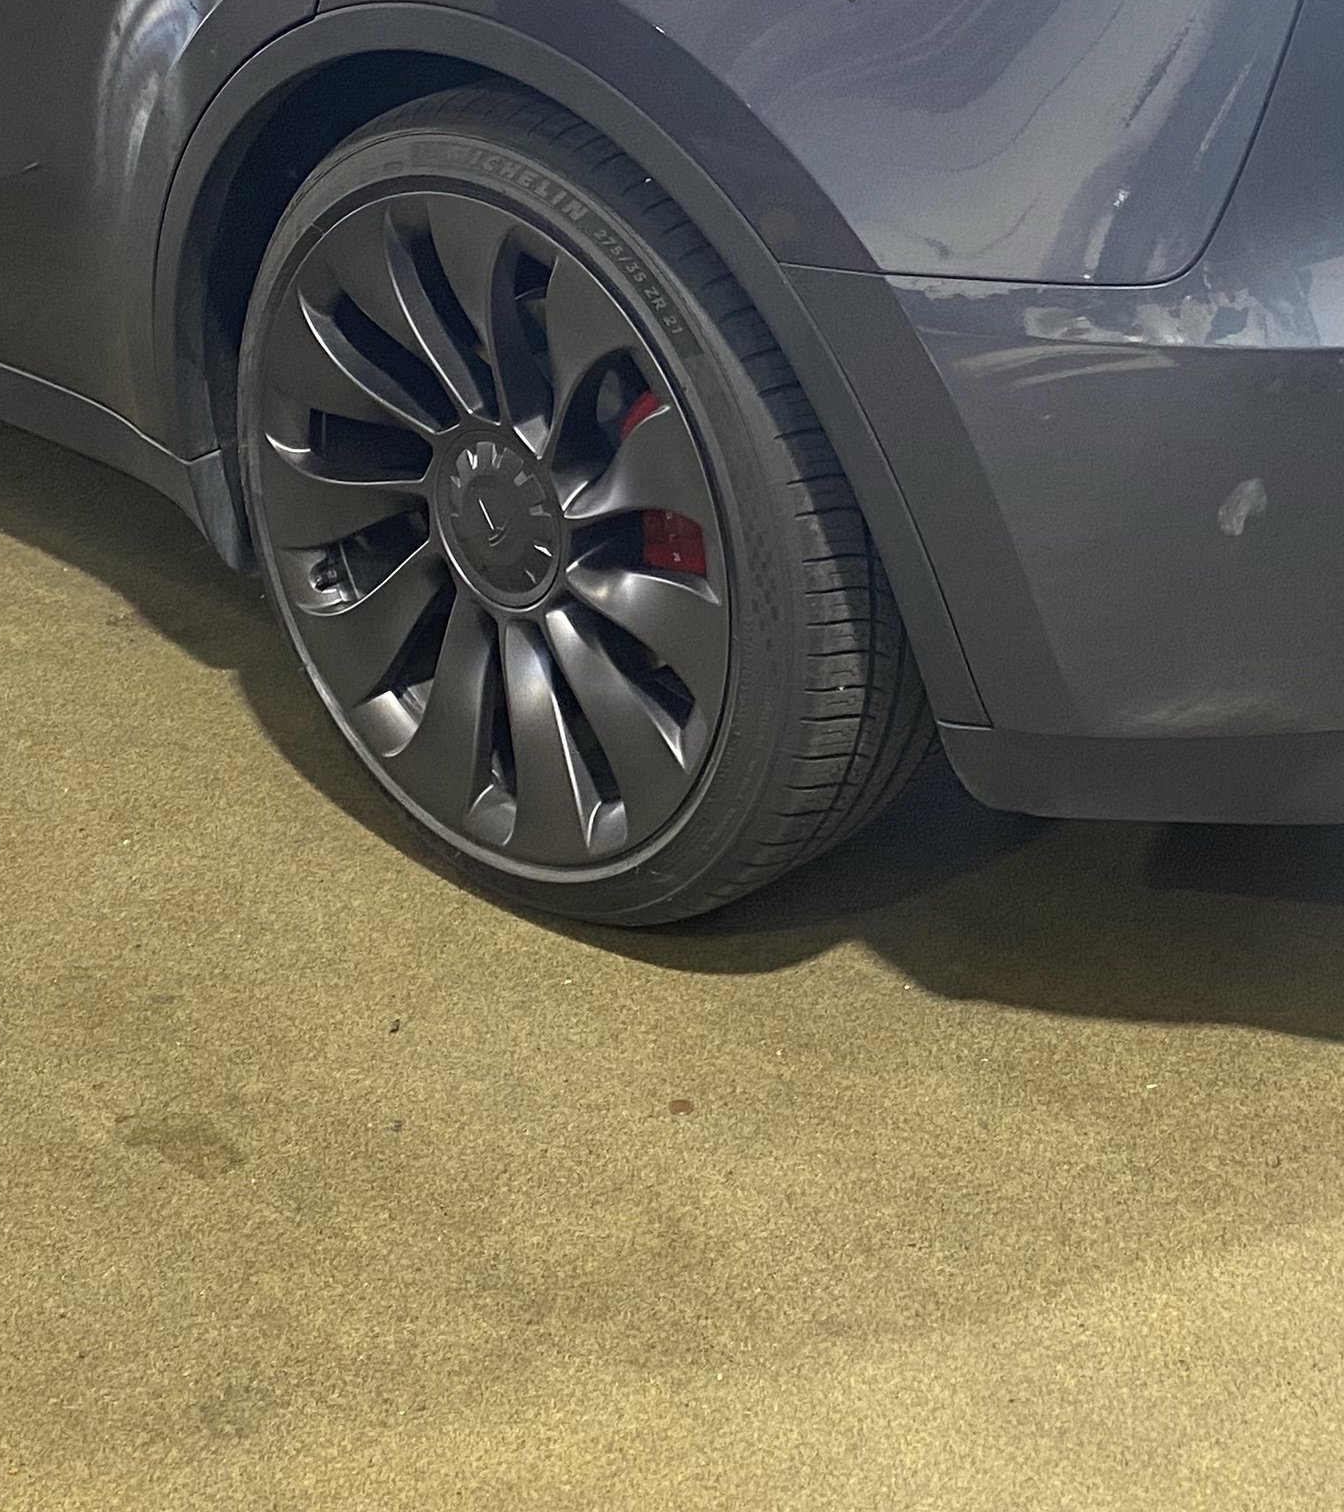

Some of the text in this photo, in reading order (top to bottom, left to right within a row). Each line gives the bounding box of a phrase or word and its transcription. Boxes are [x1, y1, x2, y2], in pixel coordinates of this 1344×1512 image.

[448, 143, 685, 336] MICHELIN 275/35 ZR 21
